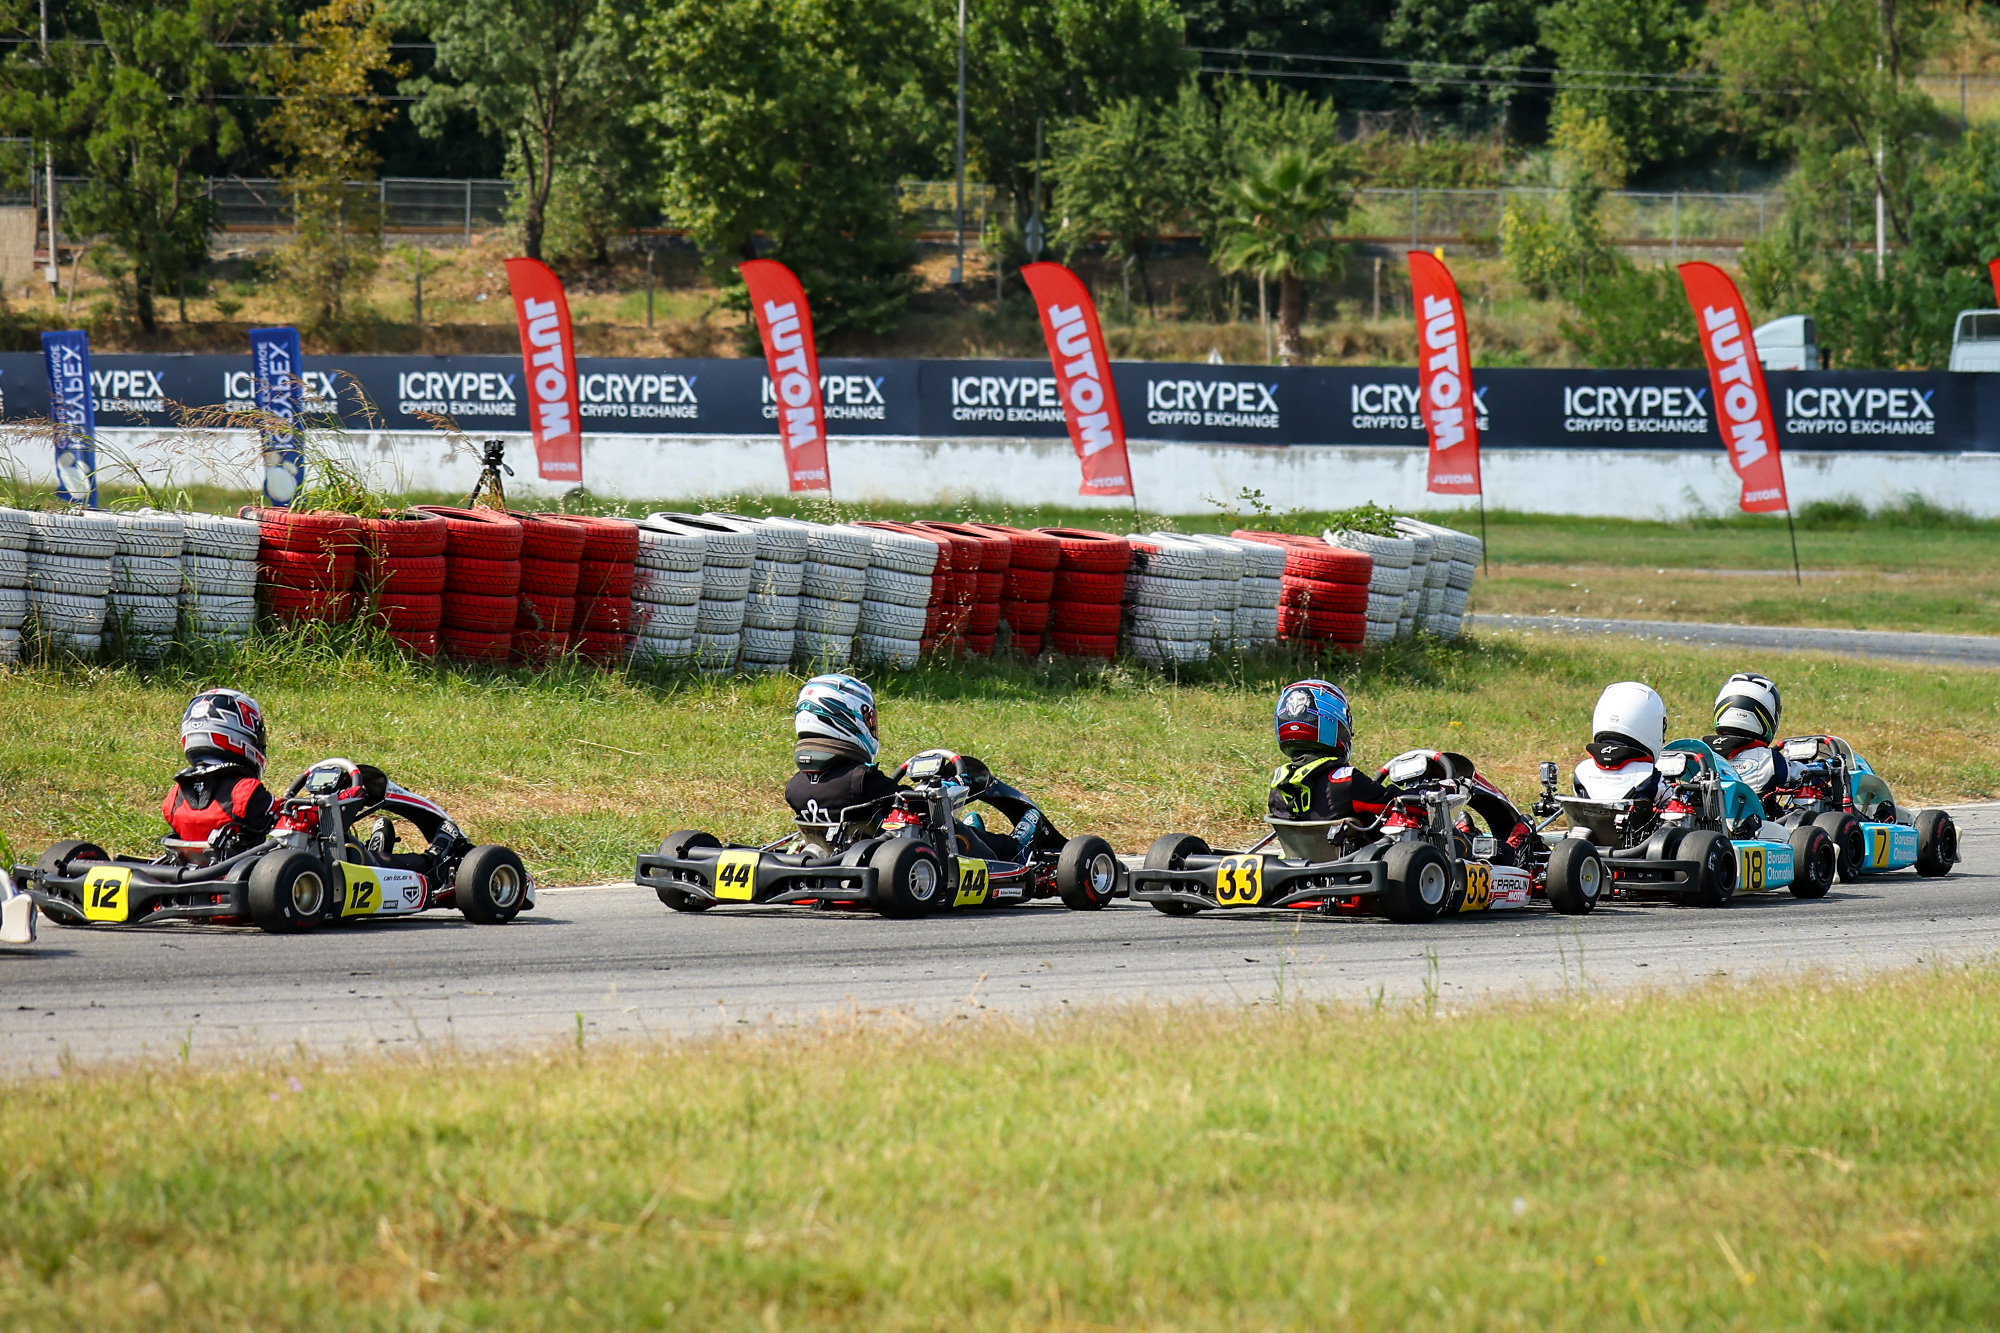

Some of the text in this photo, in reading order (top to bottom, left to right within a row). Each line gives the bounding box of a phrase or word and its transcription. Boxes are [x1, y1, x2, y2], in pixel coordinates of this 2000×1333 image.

[399, 372, 516, 400] ICRYPEX
[579, 374, 698, 403] ICRYPEX
[952, 376, 1062, 406] ICRYPE
[1148, 379, 1279, 412] ICRYPEX
[1351, 384, 1489, 415] ICRYX
[400, 401, 516, 416] CRYPTO EXCHANGE
[579, 403, 698, 418] CRYPTO EXCHANGE
[823, 405, 886, 419] XCHANGE
[952, 407, 1005, 421] CRYPTO
[1564, 386, 1708, 417] ICRYPEX
[1785, 388, 1935, 419] ICRYPEX
[1148, 411, 1279, 428] CRYPTO EXCHANGE
[1352, 415, 1409, 429] CRYPTO
[1564, 417, 1708, 433] CRYPTO EXCHANGE
[1786, 419, 1935, 435] CRYPTO EXCHANGE
[1877, 829, 1887, 865] 7
[1894, 832, 1916, 846] Borusan
[1745, 850, 1763, 889] 18
[1767, 850, 1791, 864] Borusan
[719, 863, 752, 888] 44
[960, 868, 986, 897] 44
[1218, 858, 1258, 900] 33
[1467, 867, 1489, 904] 33
[1496, 879, 1529, 890] PAROLIN
[1767, 866, 1793, 880] Otomotiv
[92, 879, 122, 909] 12
[350, 881, 374, 909] 12
